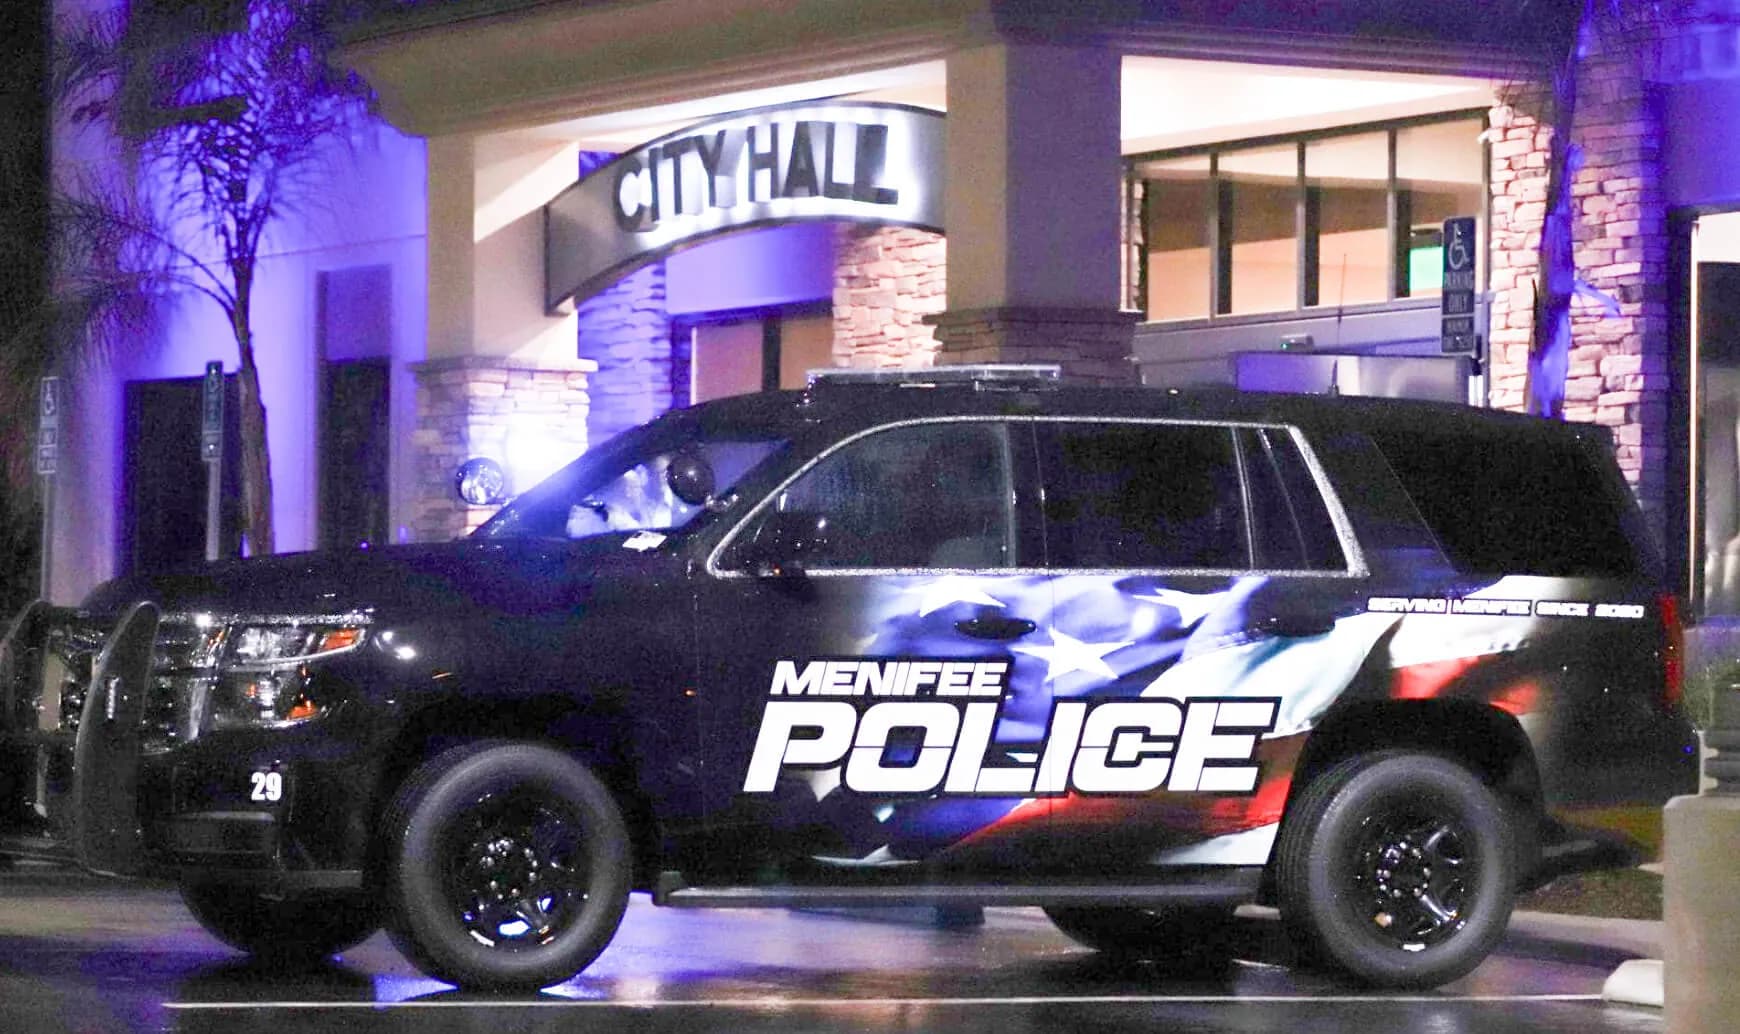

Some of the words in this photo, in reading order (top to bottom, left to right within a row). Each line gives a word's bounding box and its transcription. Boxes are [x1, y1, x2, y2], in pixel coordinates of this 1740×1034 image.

[614, 129, 727, 233] CITY
[747, 121, 898, 206] HALL
[1368, 597, 1447, 613] SERVING
[1453, 599, 1531, 614] MENIFEE
[769, 660, 1008, 696] MENIFEE
[742, 701, 1276, 793] POLICE
[251, 772, 282, 801] 29
